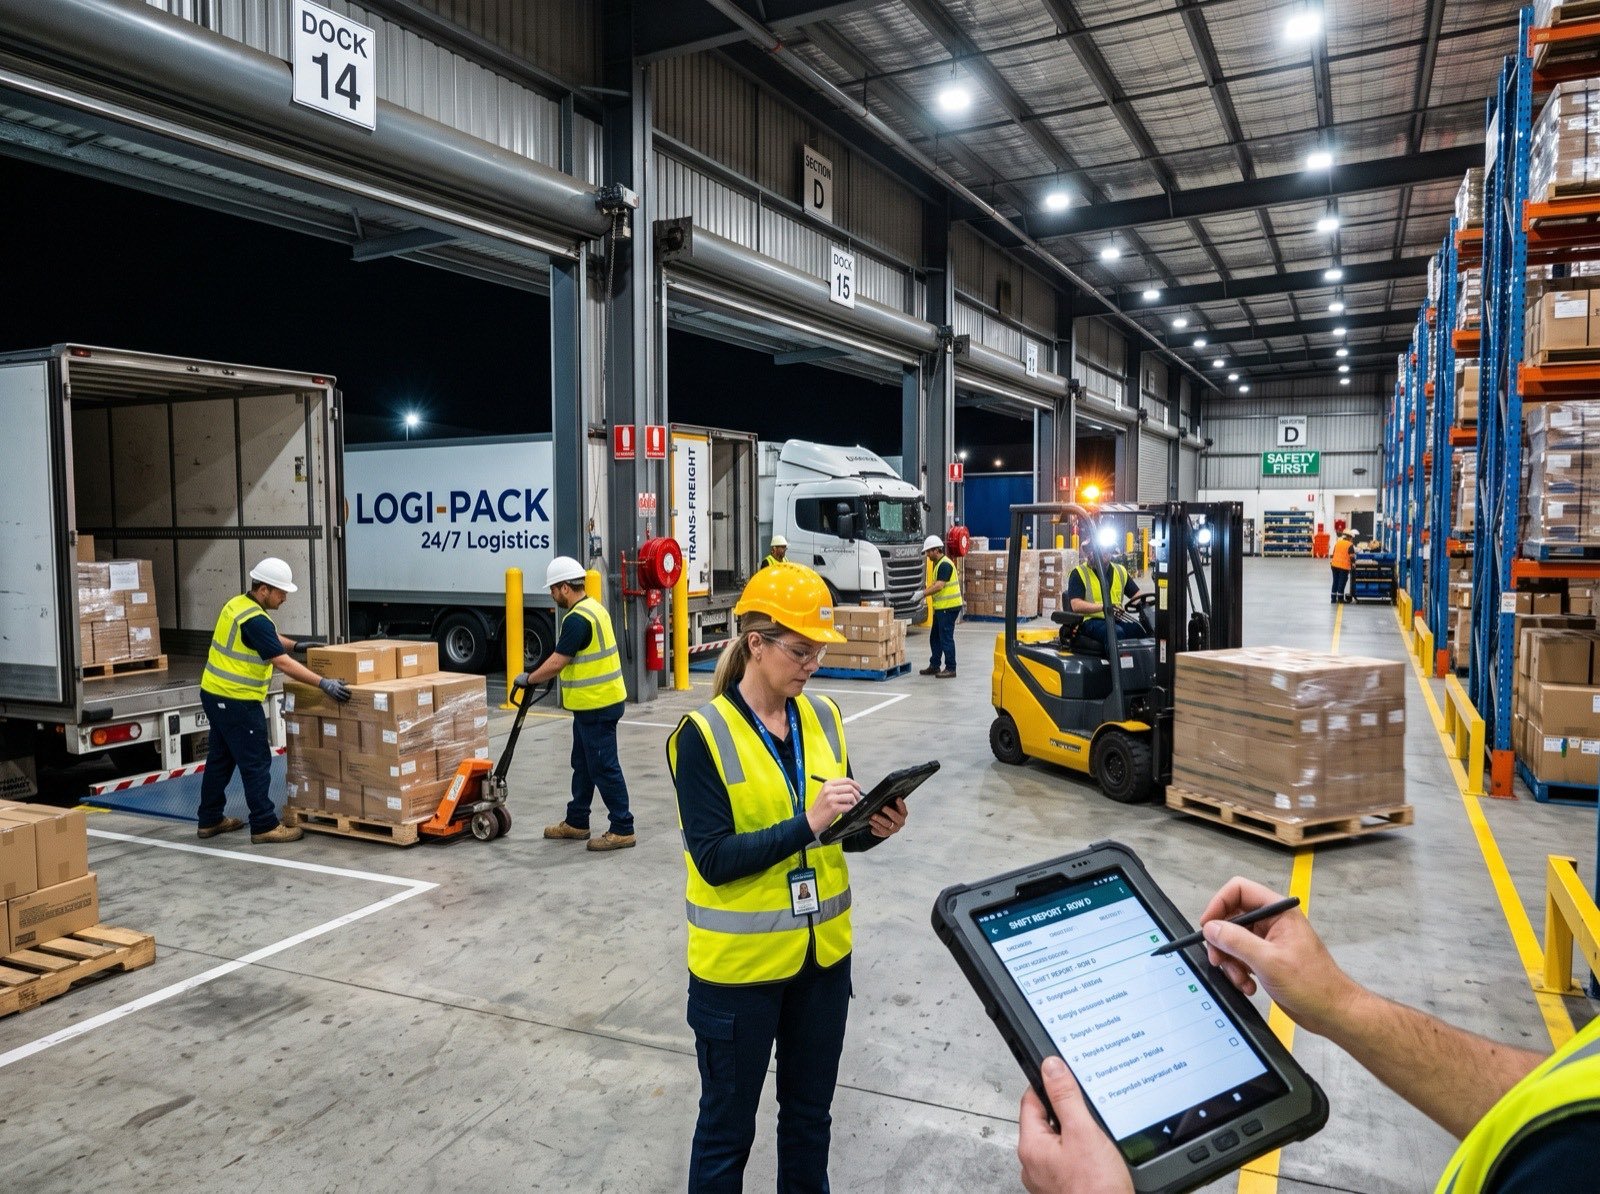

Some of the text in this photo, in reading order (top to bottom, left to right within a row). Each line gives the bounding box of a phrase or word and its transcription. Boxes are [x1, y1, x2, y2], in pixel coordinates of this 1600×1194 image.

[302, 10, 368, 59] DOCK
[312, 52, 361, 111] 14
[805, 154, 832, 181] SECTION
[813, 178, 825, 210] D
[833, 253, 853, 272] DOCK
[837, 273, 850, 299] 15
[1284, 427, 1299, 442] D
[1267, 453, 1315, 464] SAFETY
[1273, 463, 1309, 474] FIRST
[356, 488, 550, 524] LOGI-PACK
[688, 446, 696, 563] TRANS-FREIGHT
[421, 530, 550, 553] 24/7 Logistics
[1008, 916, 1032, 930] SHIFT
[1032, 906, 1062, 923] REPORT
[1066, 900, 1085, 912] ROW
[1084, 897, 1092, 905] D
